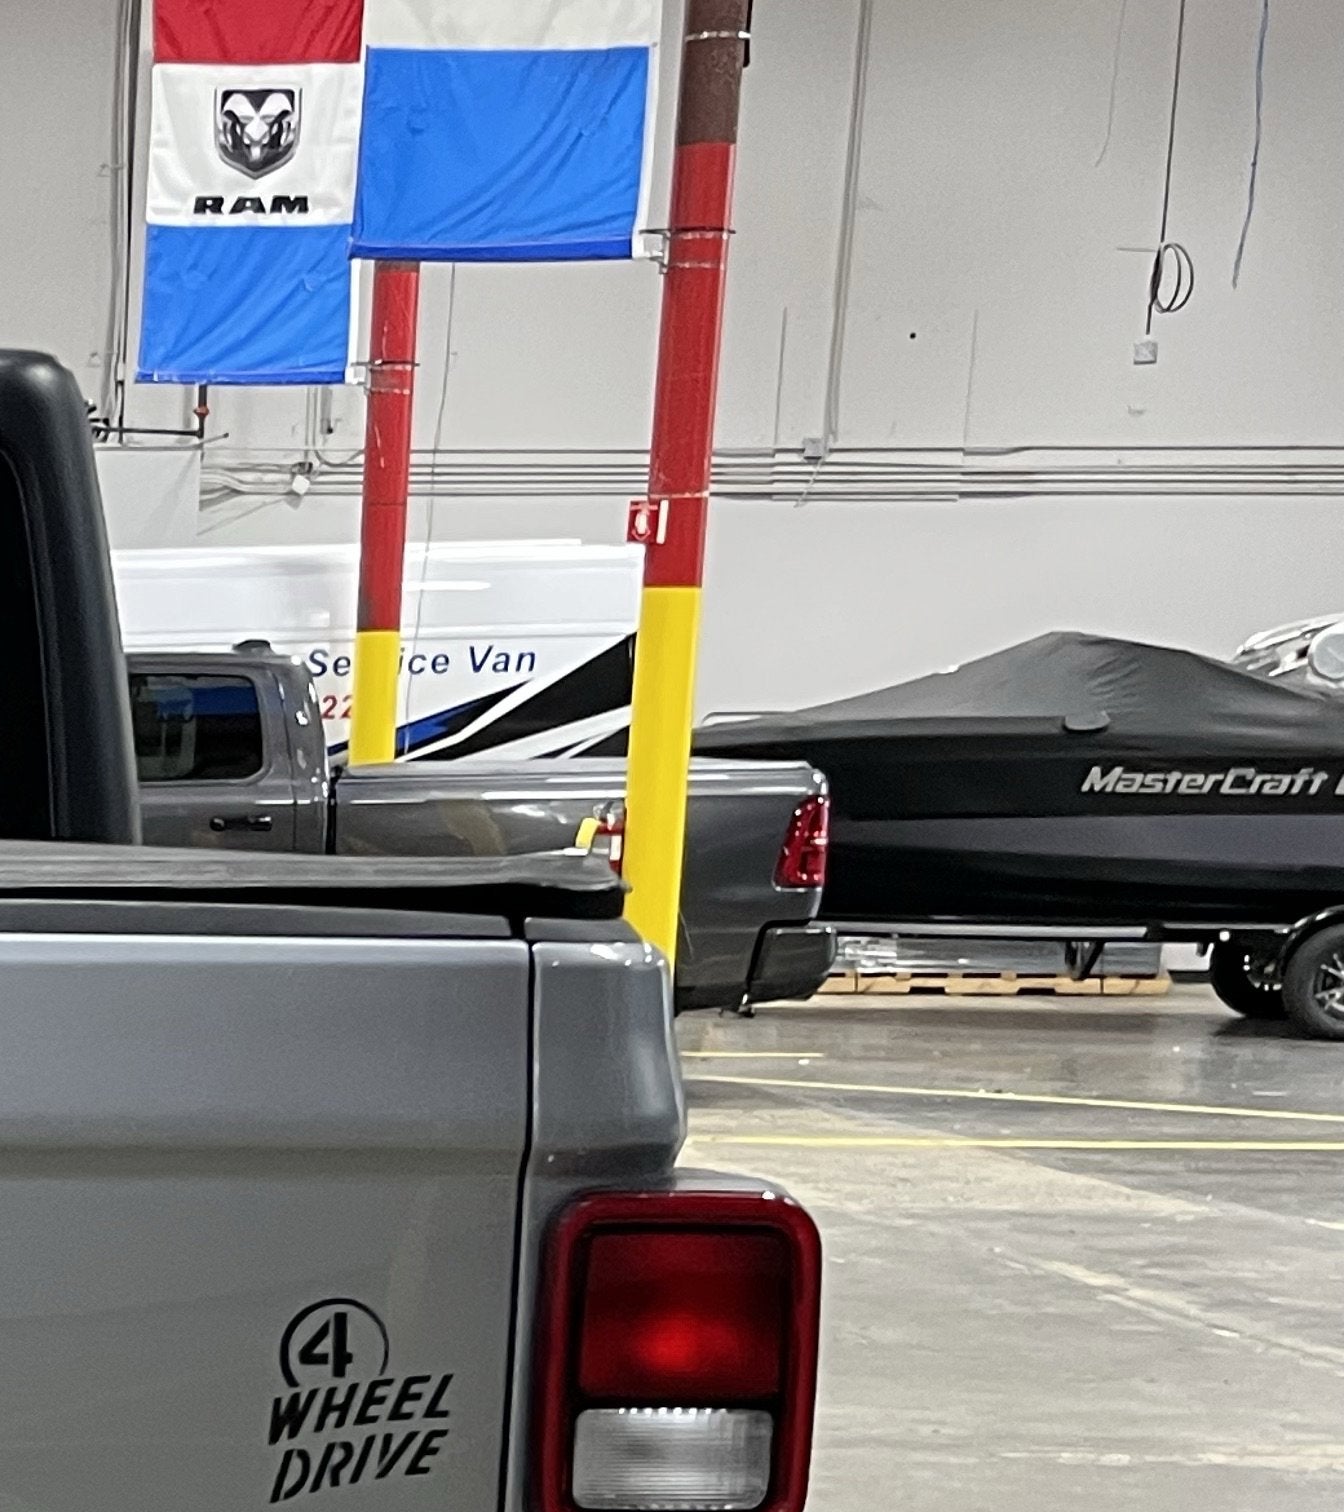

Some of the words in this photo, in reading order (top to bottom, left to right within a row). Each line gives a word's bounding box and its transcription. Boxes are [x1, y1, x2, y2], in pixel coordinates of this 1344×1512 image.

[193, 194, 309, 215] RAM
[308, 647, 450, 678] Seice
[468, 644, 537, 674] Van
[1080, 766, 1329, 795] MasterCraft
[298, 1312, 353, 1378] 4
[268, 1373, 454, 1445] WHEEL
[269, 1429, 450, 1504] DRIVE
